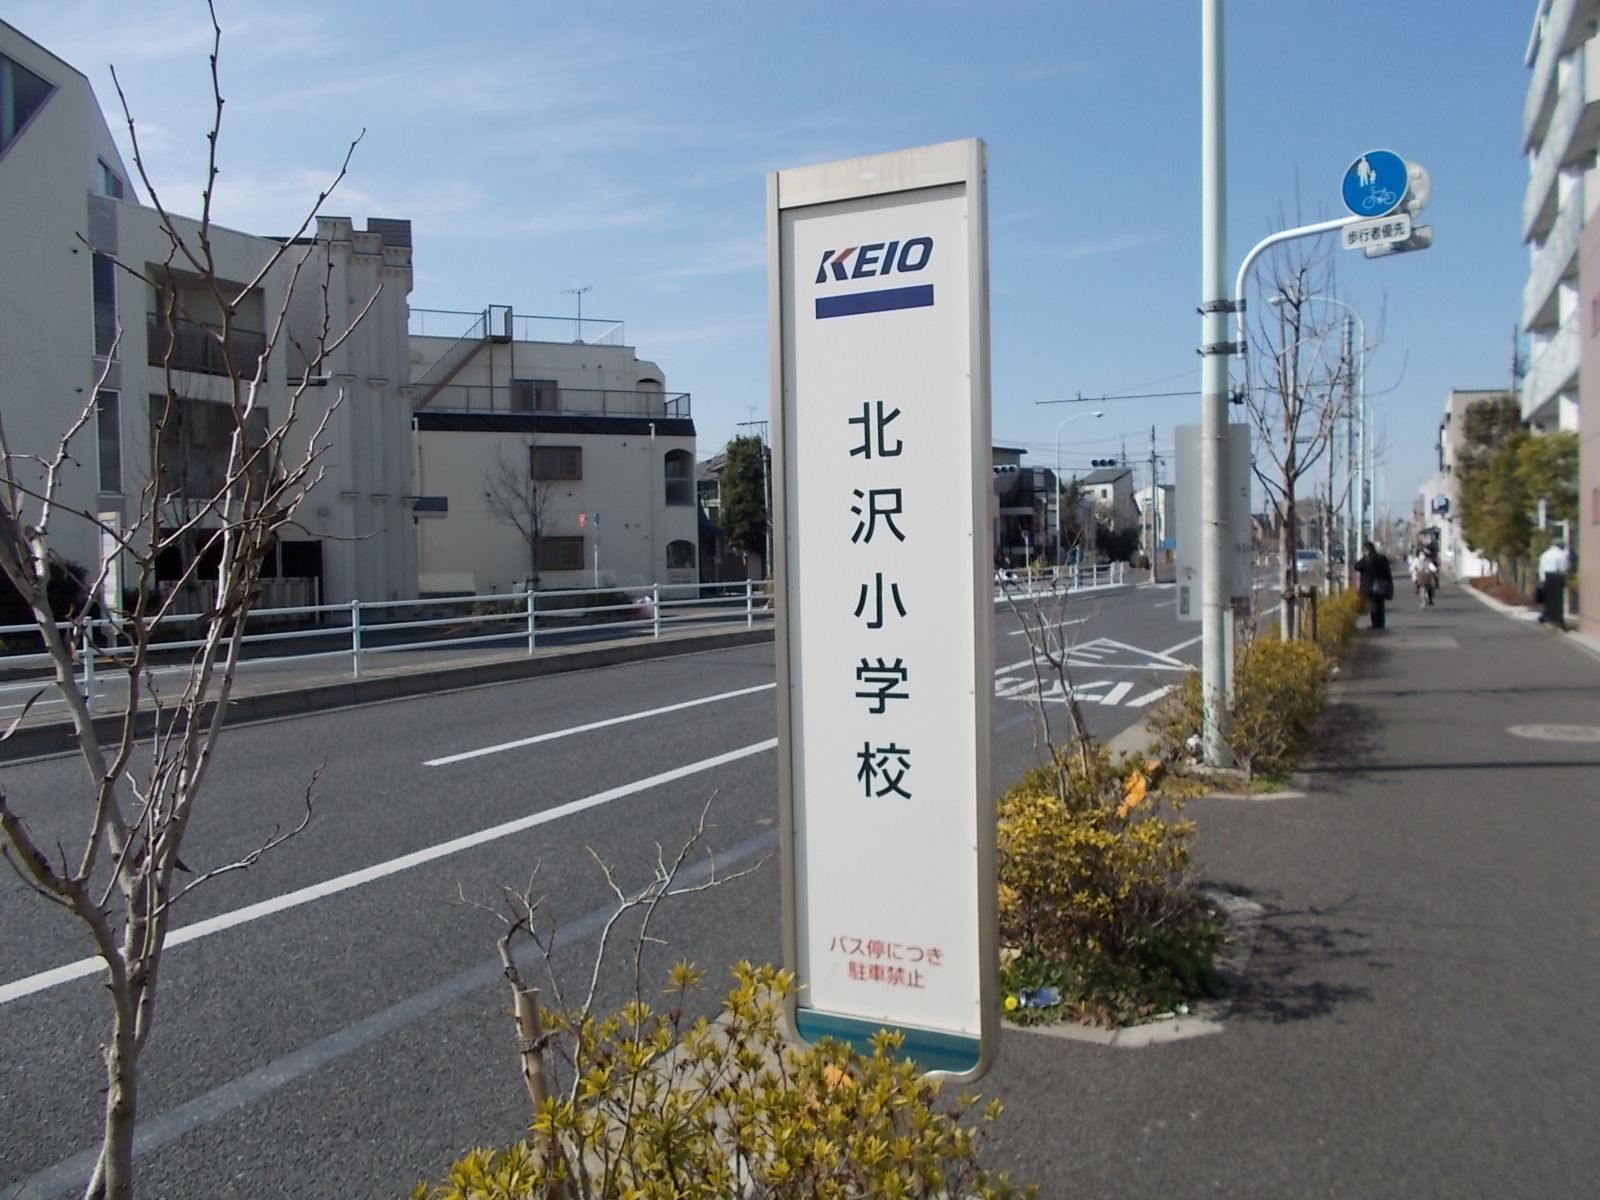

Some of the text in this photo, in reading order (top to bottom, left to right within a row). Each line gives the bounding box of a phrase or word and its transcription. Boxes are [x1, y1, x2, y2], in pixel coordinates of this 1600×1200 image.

[1347, 222, 1406, 246] 歩行者優先
[815, 236, 934, 284] KEIO
[848, 400, 912, 800] 北沢小学校
[830, 935, 944, 966] バス停につき
[848, 960, 925, 989] 駐車禁止
